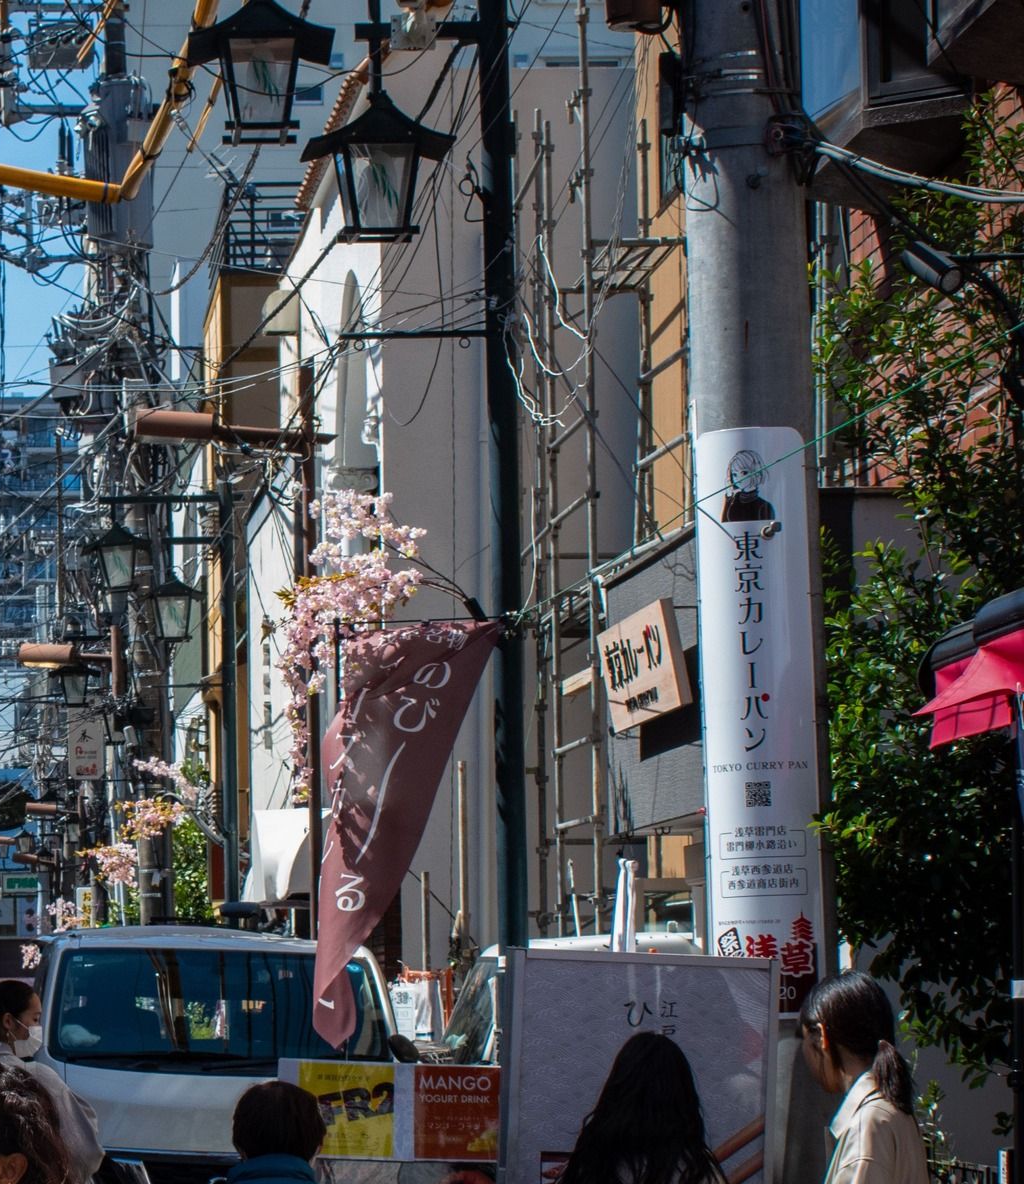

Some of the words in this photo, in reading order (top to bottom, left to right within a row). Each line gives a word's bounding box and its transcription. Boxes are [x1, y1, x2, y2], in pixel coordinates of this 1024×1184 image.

[733, 531, 770, 752] 東京カレーパン
[712, 763, 743, 774] TOKYO
[746, 761, 784, 772] CURRY
[787, 760, 809, 770] PAN
[419, 1074, 492, 1091] MANGO
[419, 1094, 458, 1104] YOGURT
[460, 1094, 491, 1104] DRINK
